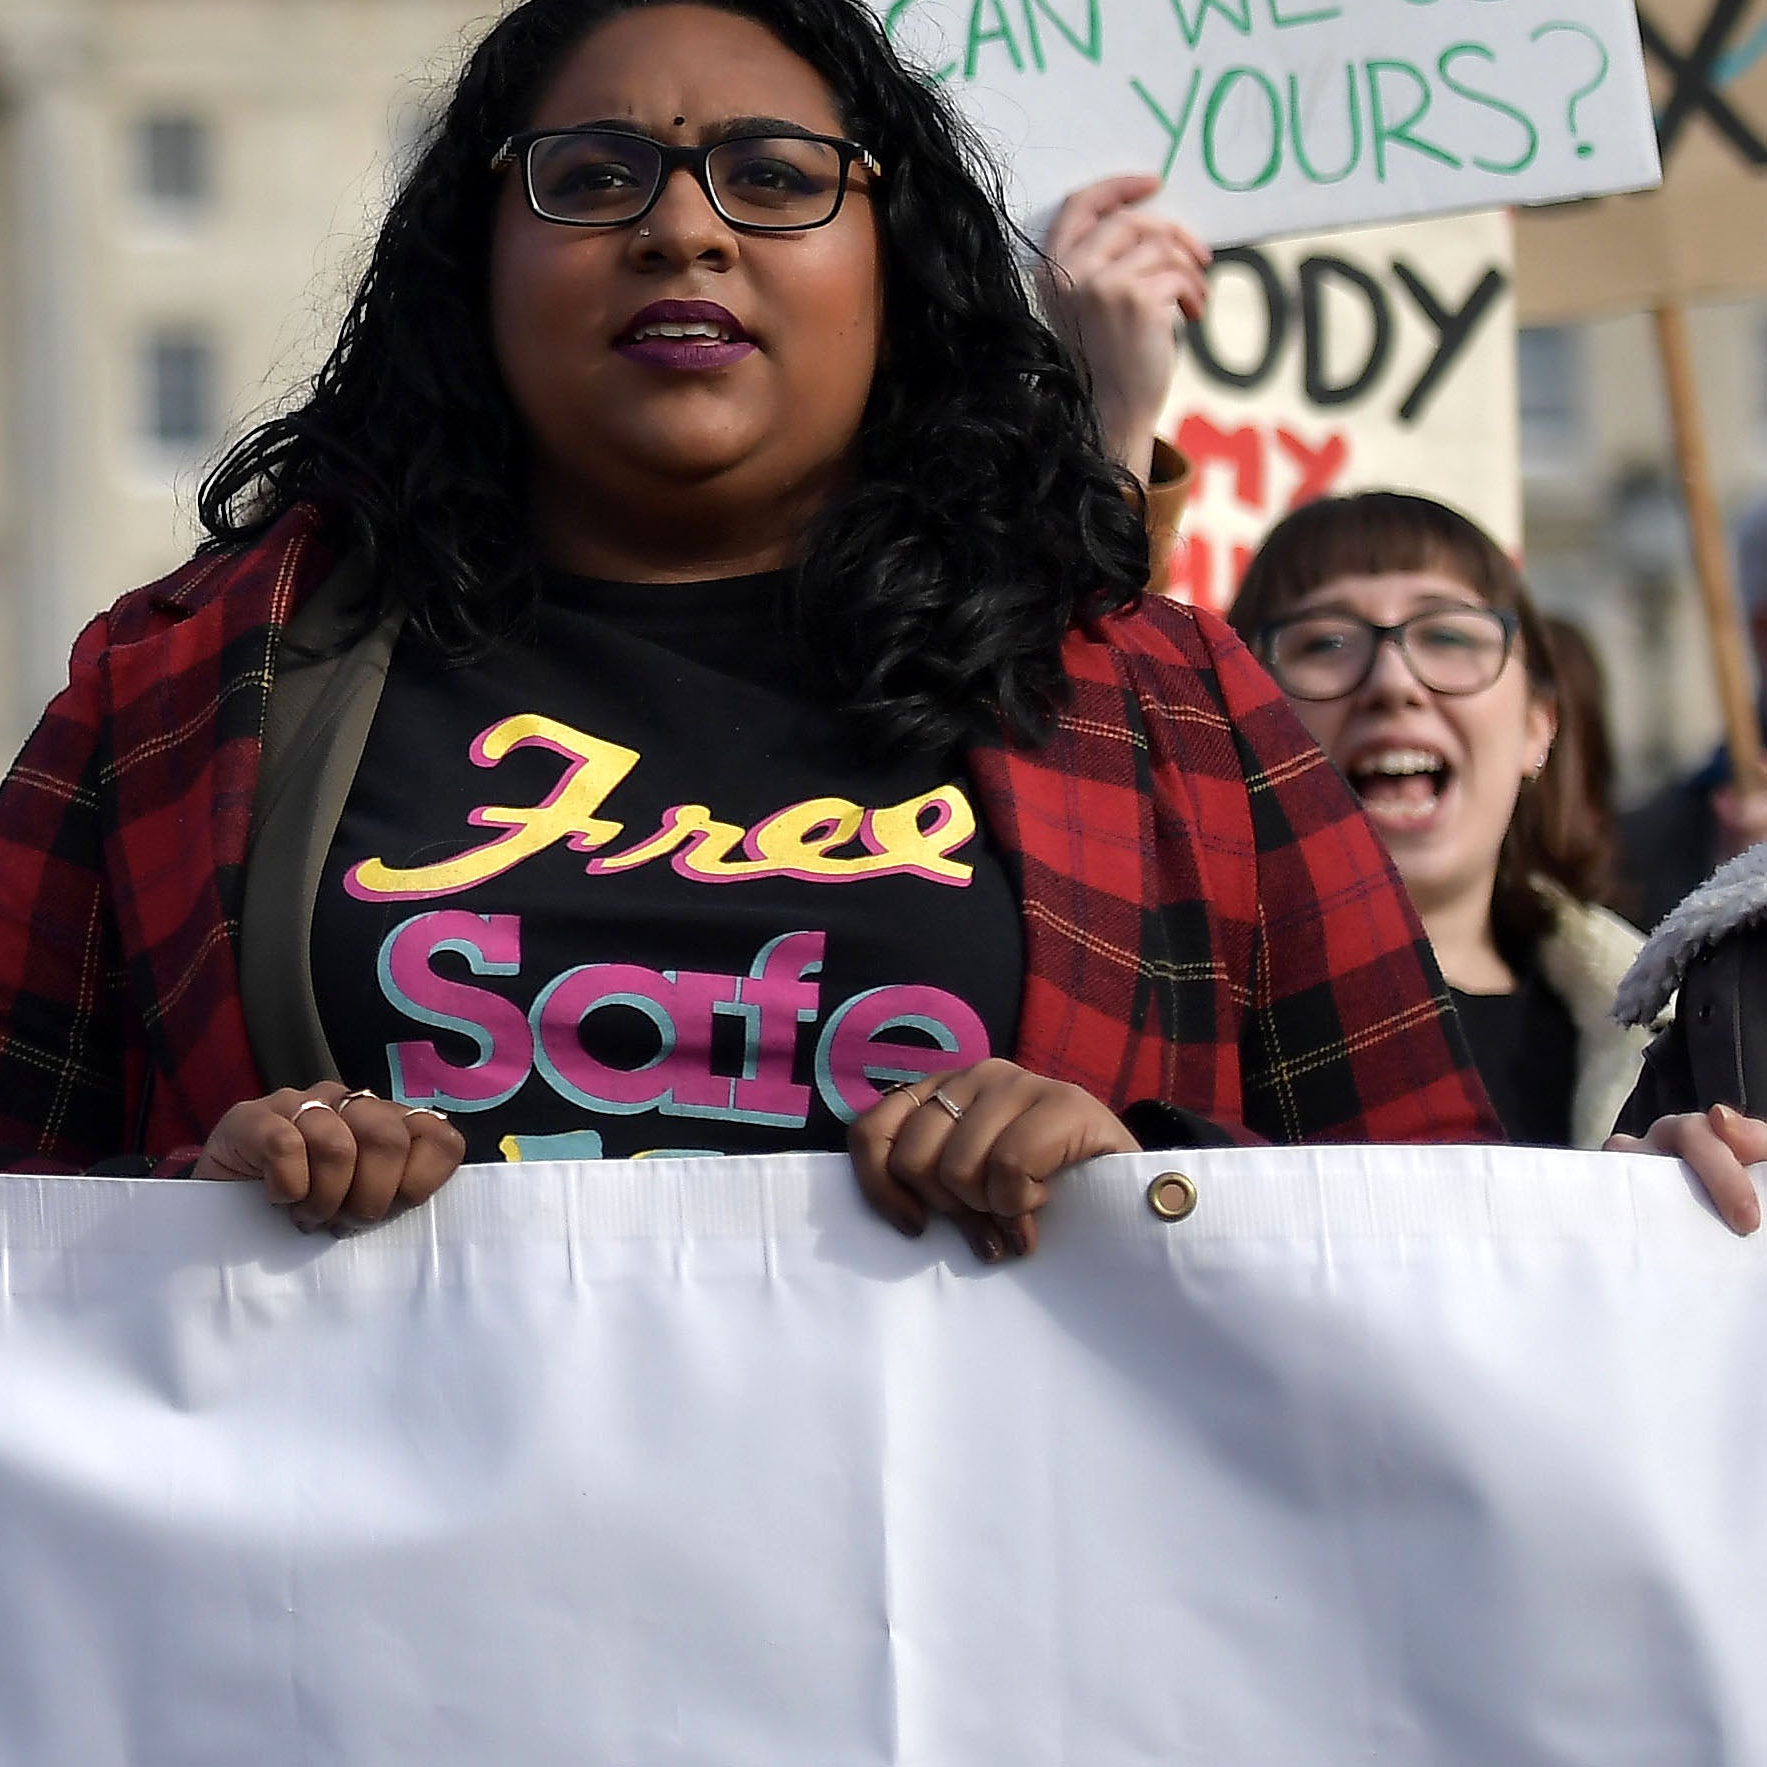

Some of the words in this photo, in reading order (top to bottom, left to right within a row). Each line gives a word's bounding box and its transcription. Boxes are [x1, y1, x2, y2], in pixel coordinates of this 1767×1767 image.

[1129, 20, 1611, 193] YOURS?
[1175, 245, 1505, 422] ODY
[342, 713, 978, 903] Free
[375, 910, 993, 1130] Safe
